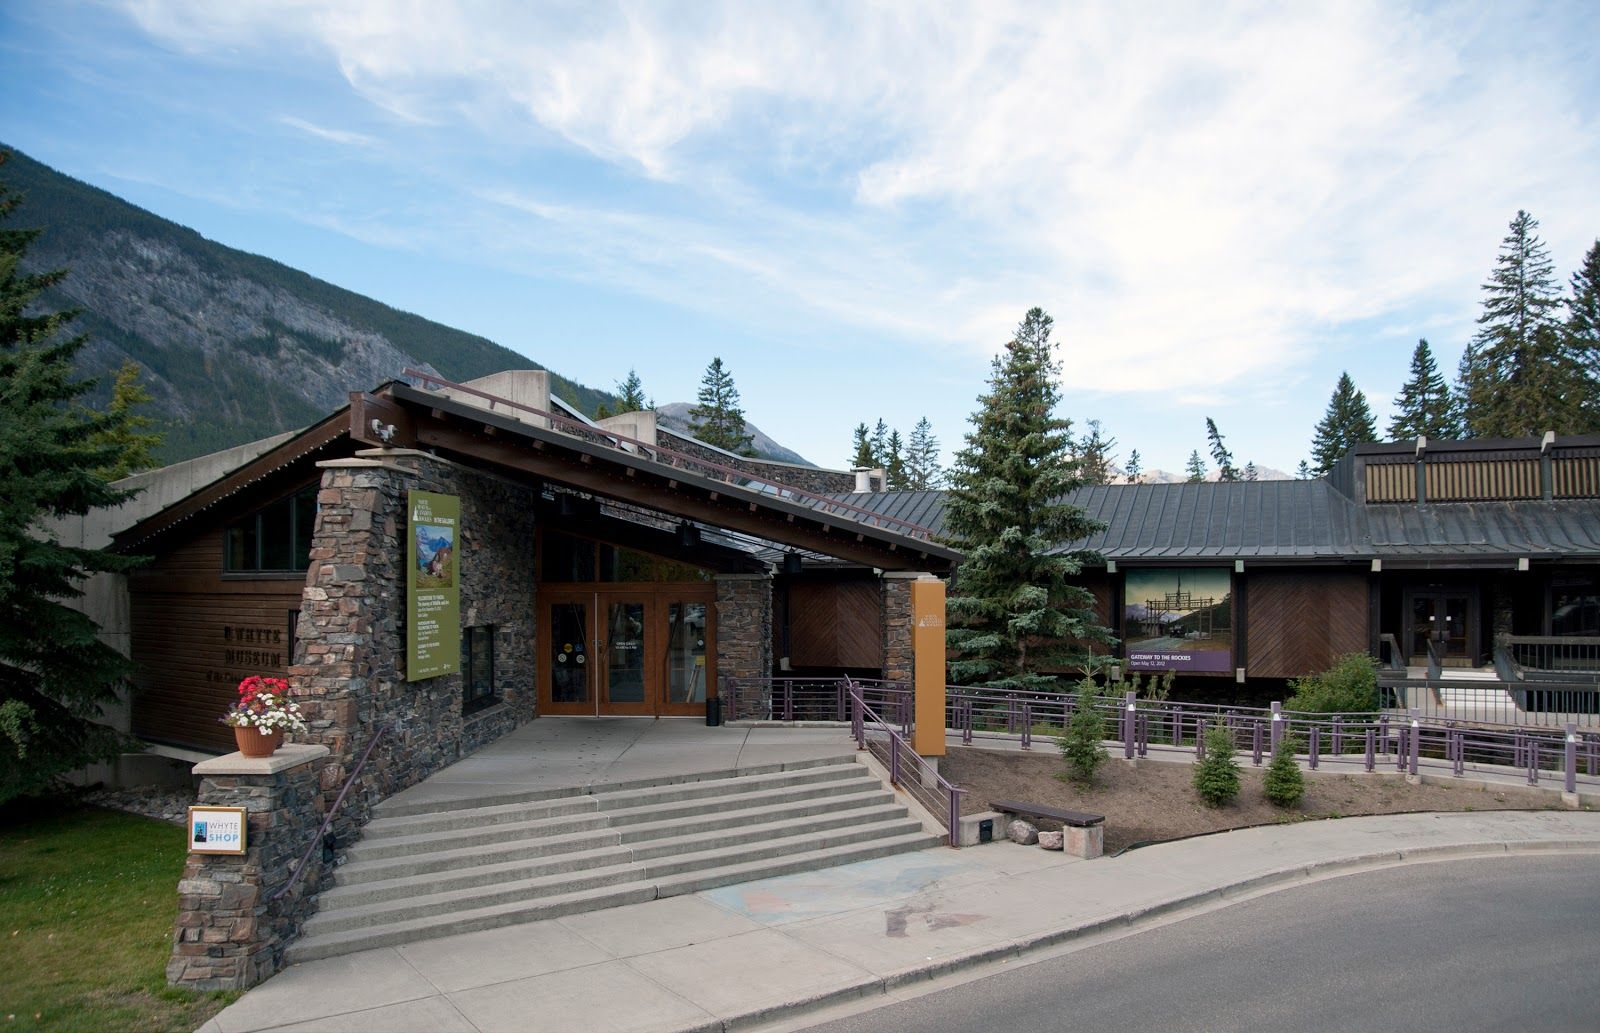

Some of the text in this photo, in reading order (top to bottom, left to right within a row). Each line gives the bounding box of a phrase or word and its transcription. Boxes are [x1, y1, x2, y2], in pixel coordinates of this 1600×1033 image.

[234, 627, 281, 643] WHYTE
[225, 649, 281, 668] MUSEUM
[209, 822, 238, 830] WHYTE
[209, 834, 239, 842] SHOP
